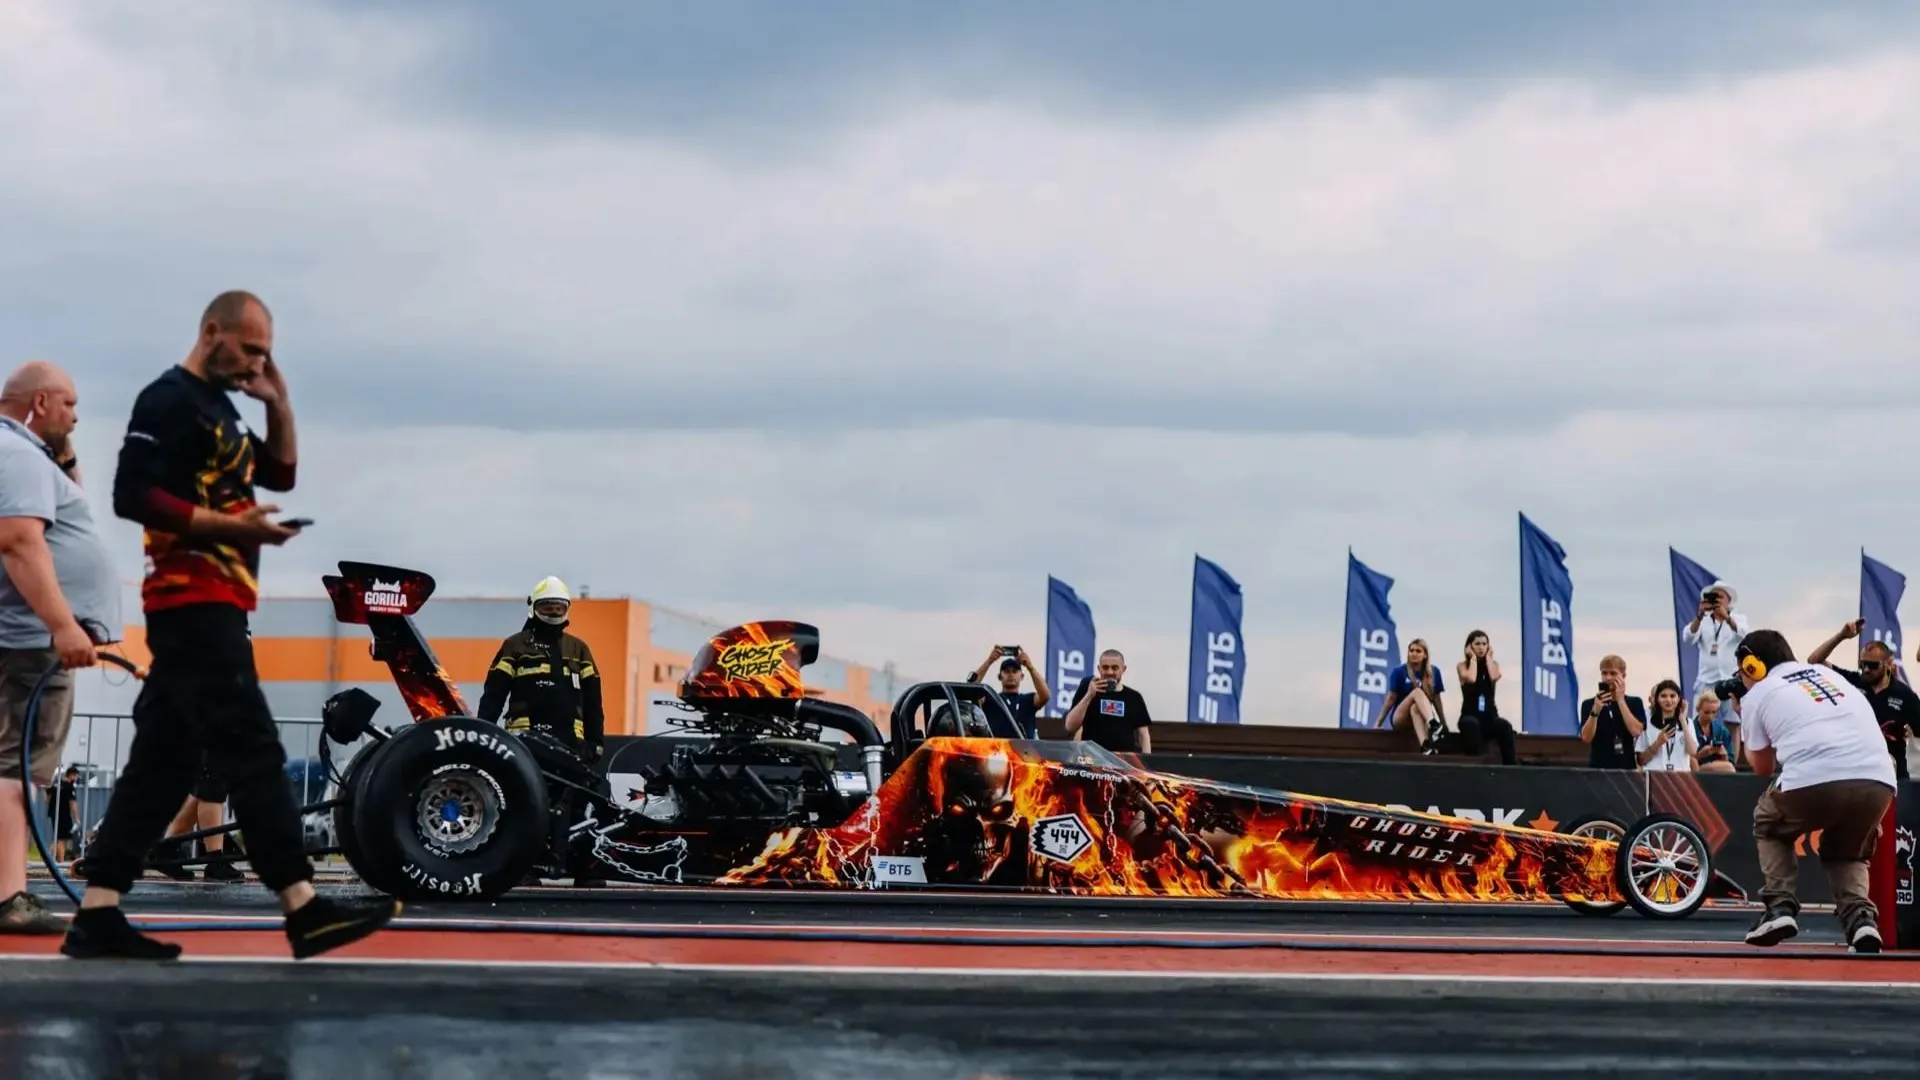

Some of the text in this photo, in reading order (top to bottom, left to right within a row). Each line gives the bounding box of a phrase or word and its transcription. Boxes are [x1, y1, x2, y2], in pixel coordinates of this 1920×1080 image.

[364, 591, 407, 607] GORILLA
[1541, 598, 1568, 666] ВТБ
[720, 643, 785, 664] GHOST
[1206, 631, 1236, 695] ВТБ
[1357, 628, 1389, 694] ВТБ
[727, 659, 782, 682] RIDER
[1059, 767, 1078, 777] Igor
[1050, 828, 1080, 845] 444
[1349, 815, 1466, 843] GHOST
[1364, 839, 1477, 867] RIDER
[889, 864, 912, 876] ВТБ
